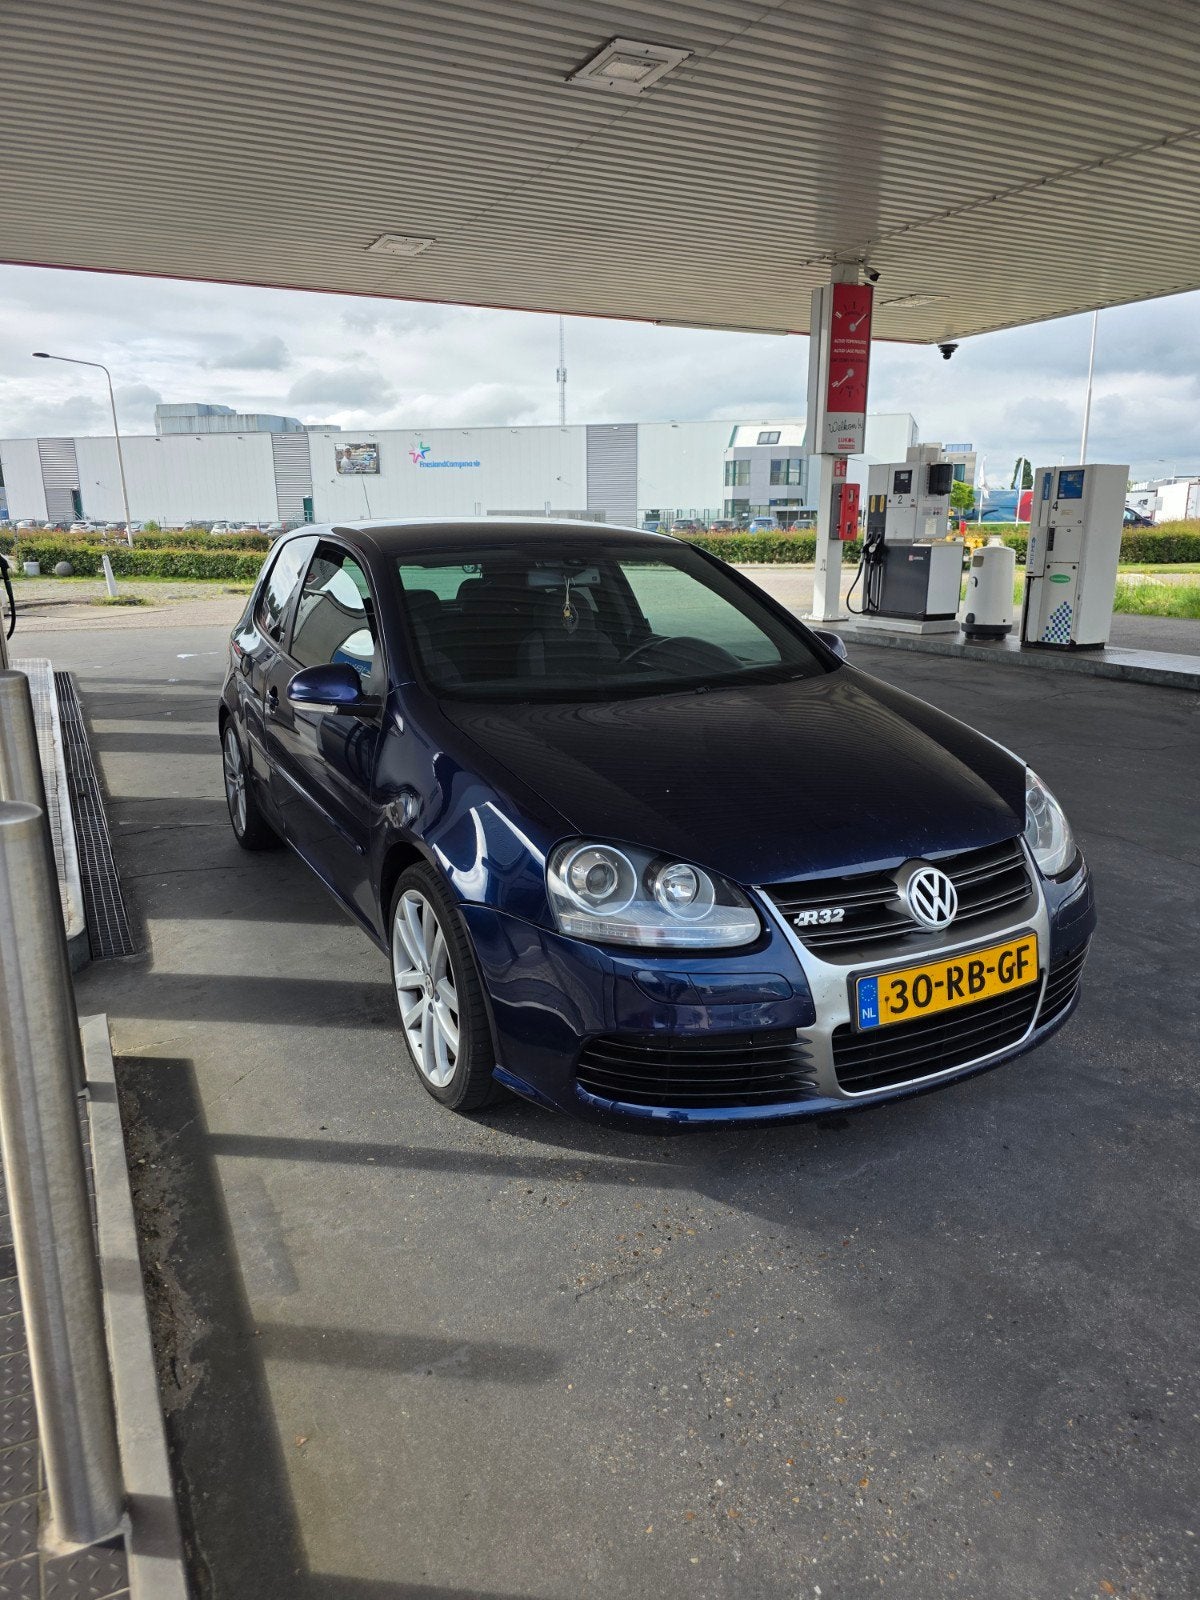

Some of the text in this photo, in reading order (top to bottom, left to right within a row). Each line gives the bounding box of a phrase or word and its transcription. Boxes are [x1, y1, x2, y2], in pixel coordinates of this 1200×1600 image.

[897, 495, 903, 504] 2
[1052, 500, 1059, 511] 4
[794, 908, 846, 926] R32
[889, 944, 1030, 1014] 30-RB-GF
[862, 1007, 877, 1019] NL
